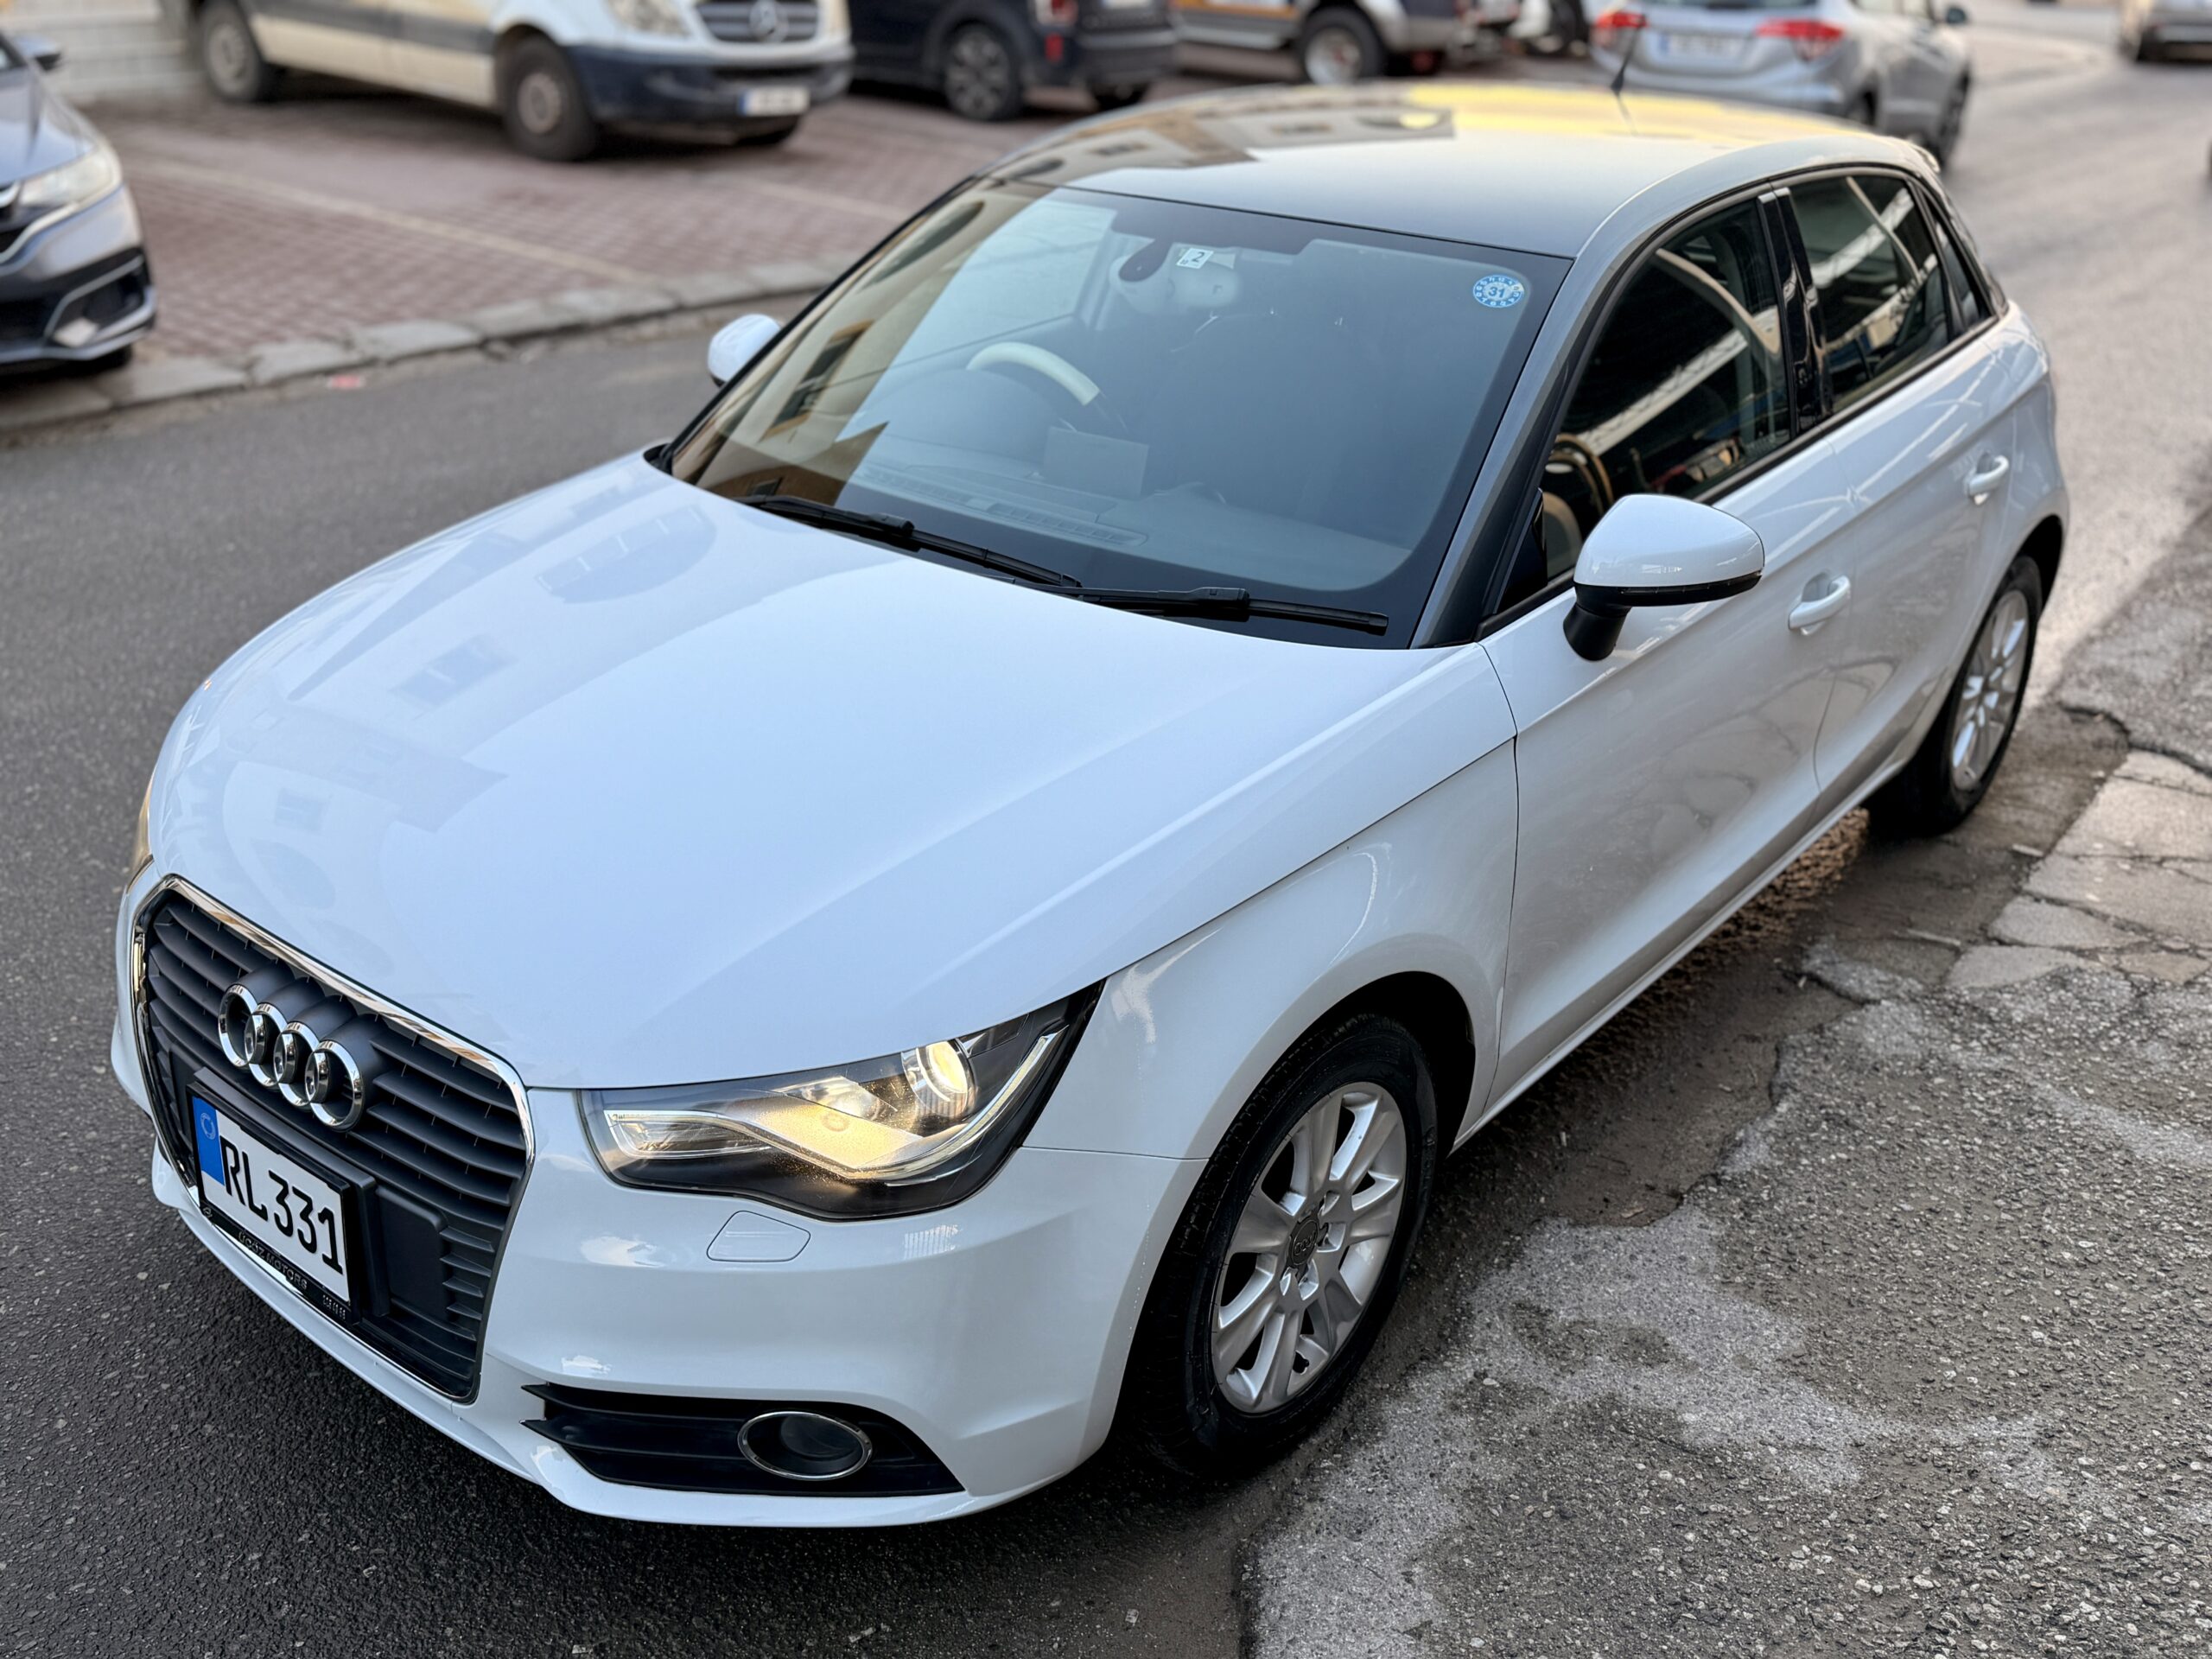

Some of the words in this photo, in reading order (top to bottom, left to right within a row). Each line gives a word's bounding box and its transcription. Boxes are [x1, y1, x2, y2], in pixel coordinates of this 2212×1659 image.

[1192, 251, 1205, 263] 2
[1488, 286, 1506, 298] 31
[266, 1252, 308, 1290] MOTORS
